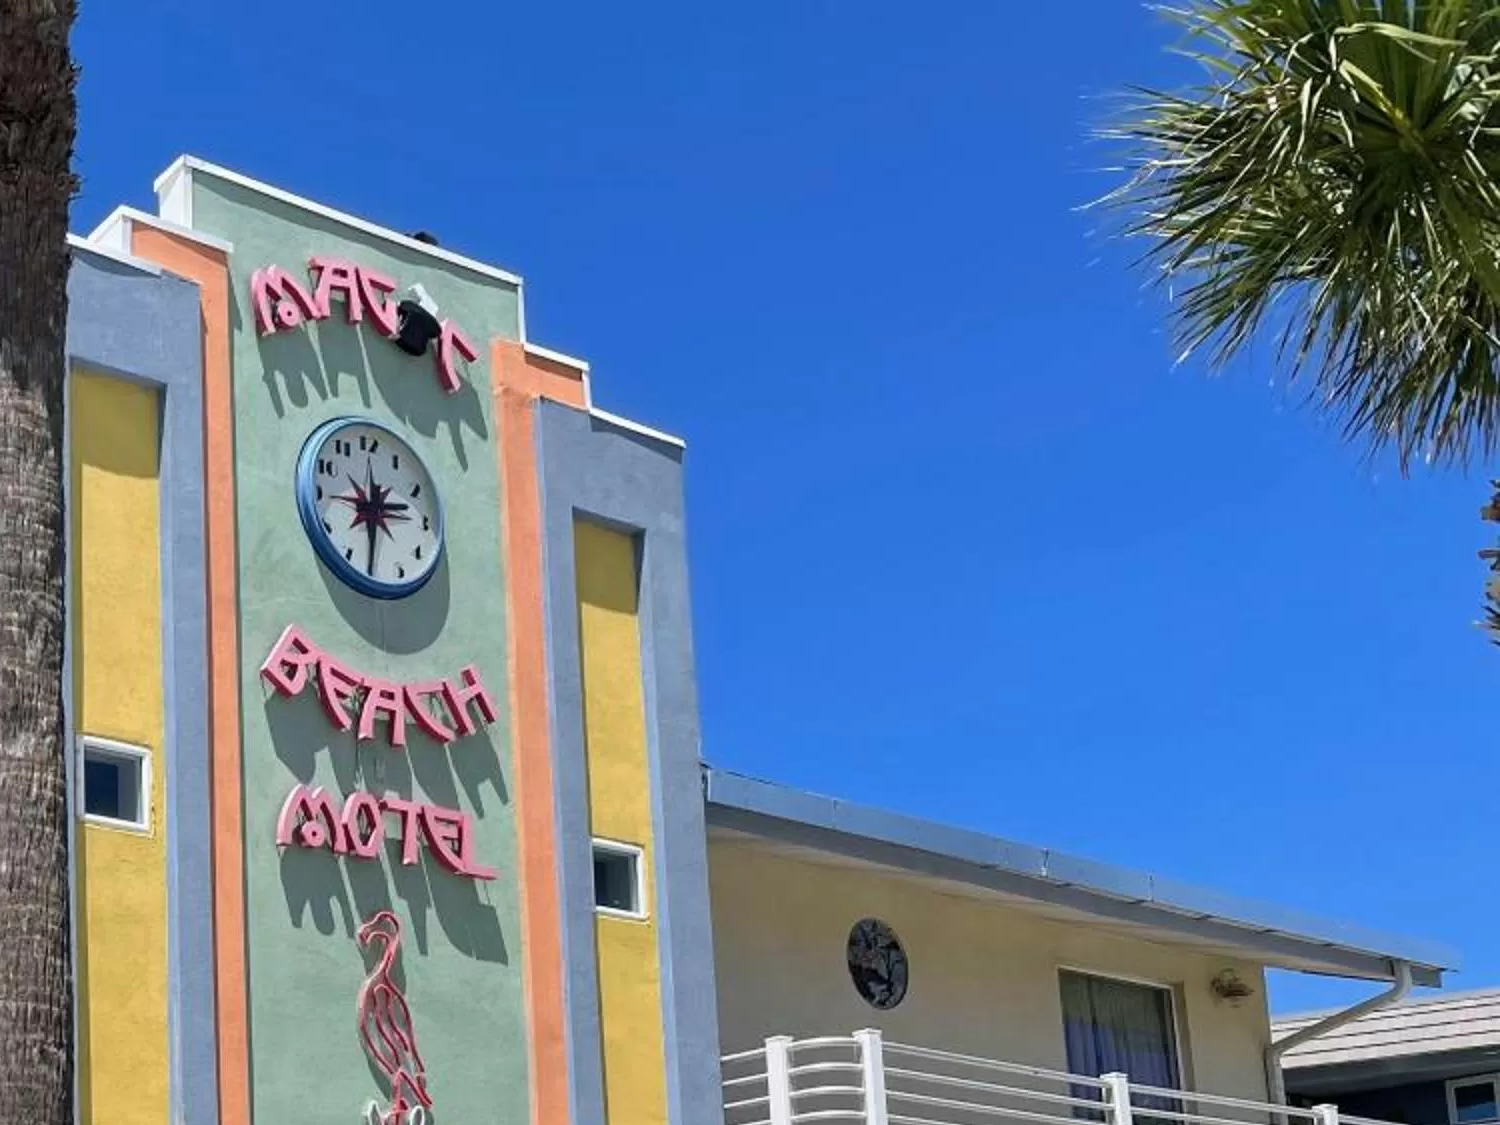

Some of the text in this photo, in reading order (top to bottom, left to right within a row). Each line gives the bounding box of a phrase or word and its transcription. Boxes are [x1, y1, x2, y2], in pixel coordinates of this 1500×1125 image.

[252, 255, 478, 393] MAGC
[260, 623, 498, 747] BEACH
[275, 783, 501, 881] MOTEL
